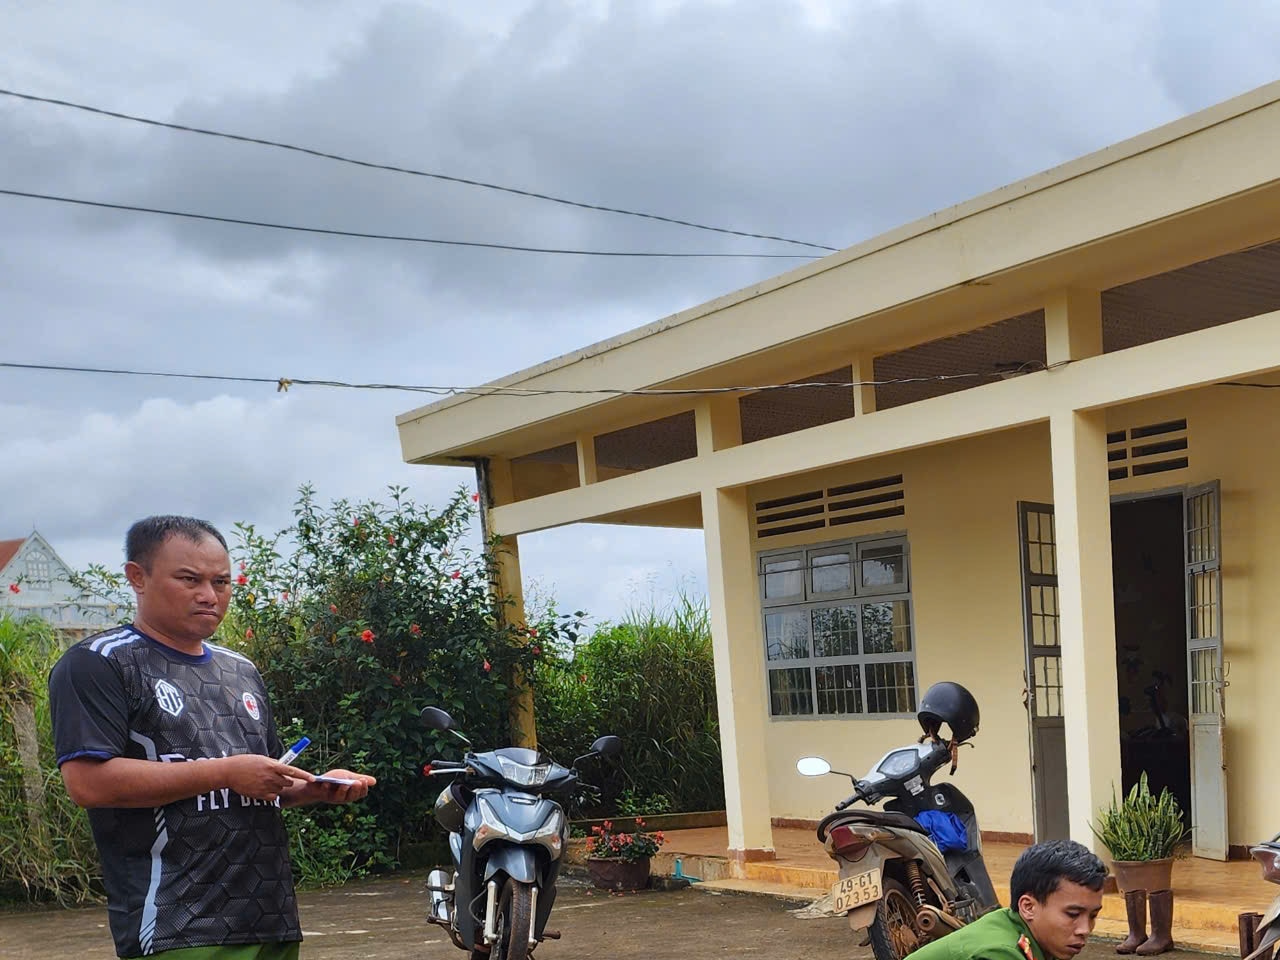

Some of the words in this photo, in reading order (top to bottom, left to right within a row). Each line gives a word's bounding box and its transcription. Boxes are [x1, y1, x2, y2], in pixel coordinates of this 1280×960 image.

[197, 788, 230, 812] FLY
[840, 872, 873, 895] 49-G1
[836, 884, 879, 910] 023.53
